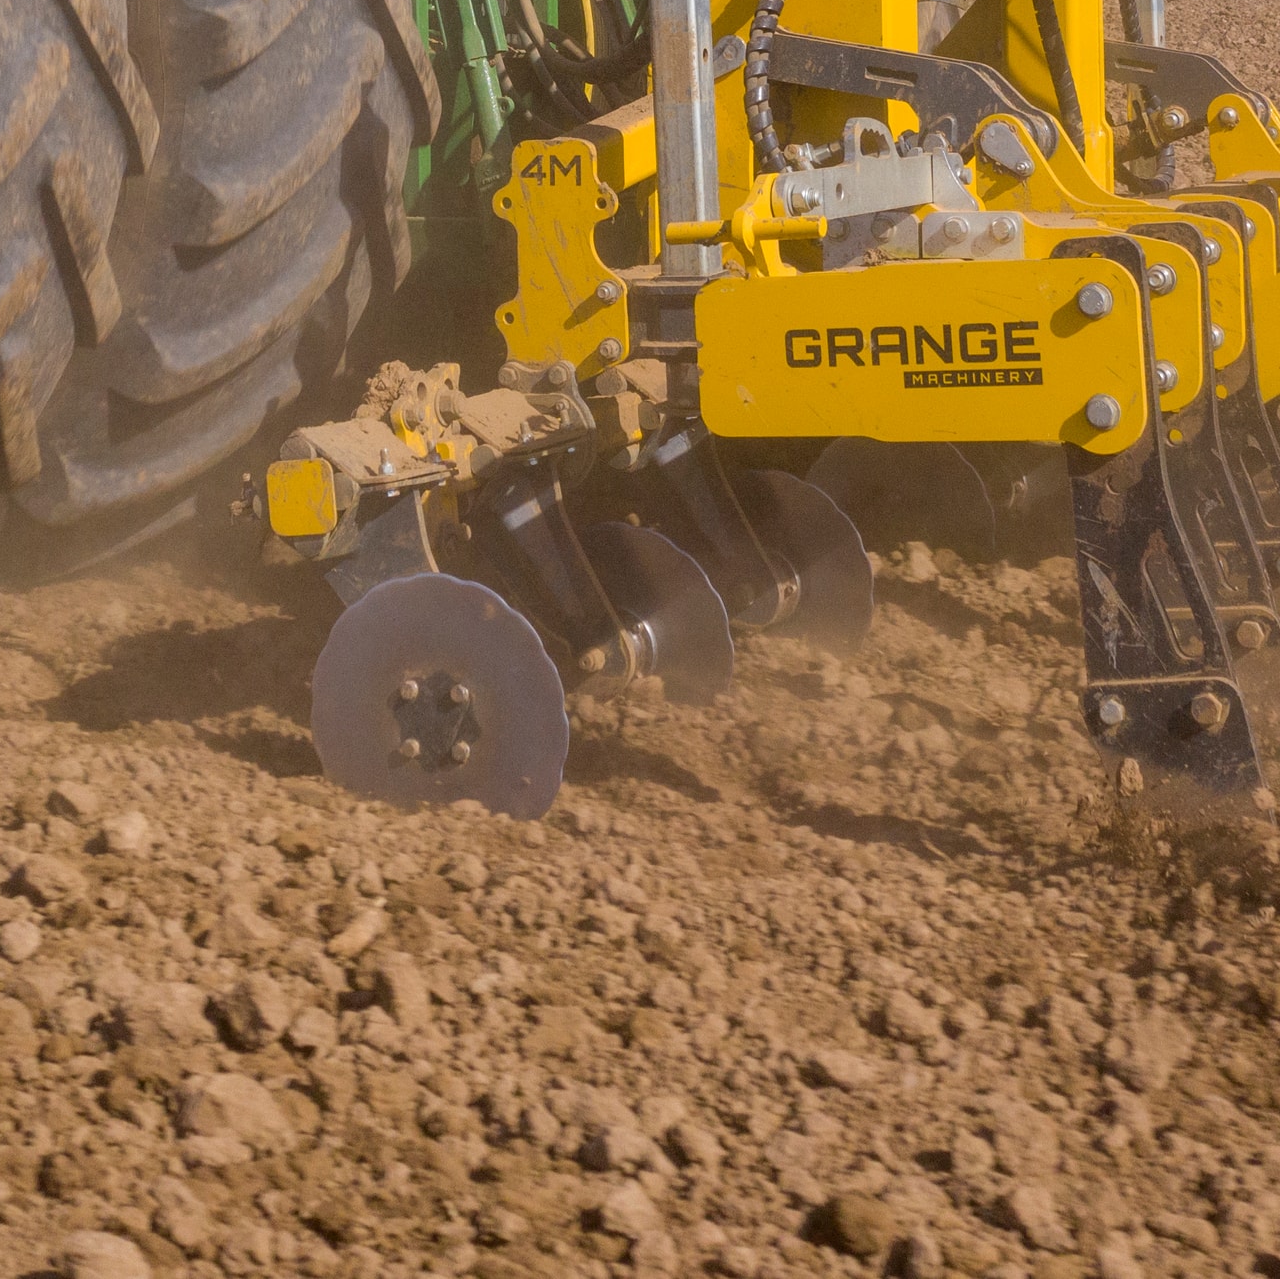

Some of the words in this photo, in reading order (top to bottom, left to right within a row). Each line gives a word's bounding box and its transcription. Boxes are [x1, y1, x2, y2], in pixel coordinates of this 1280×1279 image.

[521, 154, 582, 187] 4M
[785, 321, 1041, 369] GRANGE
[911, 370, 1036, 386] MACHINERY
